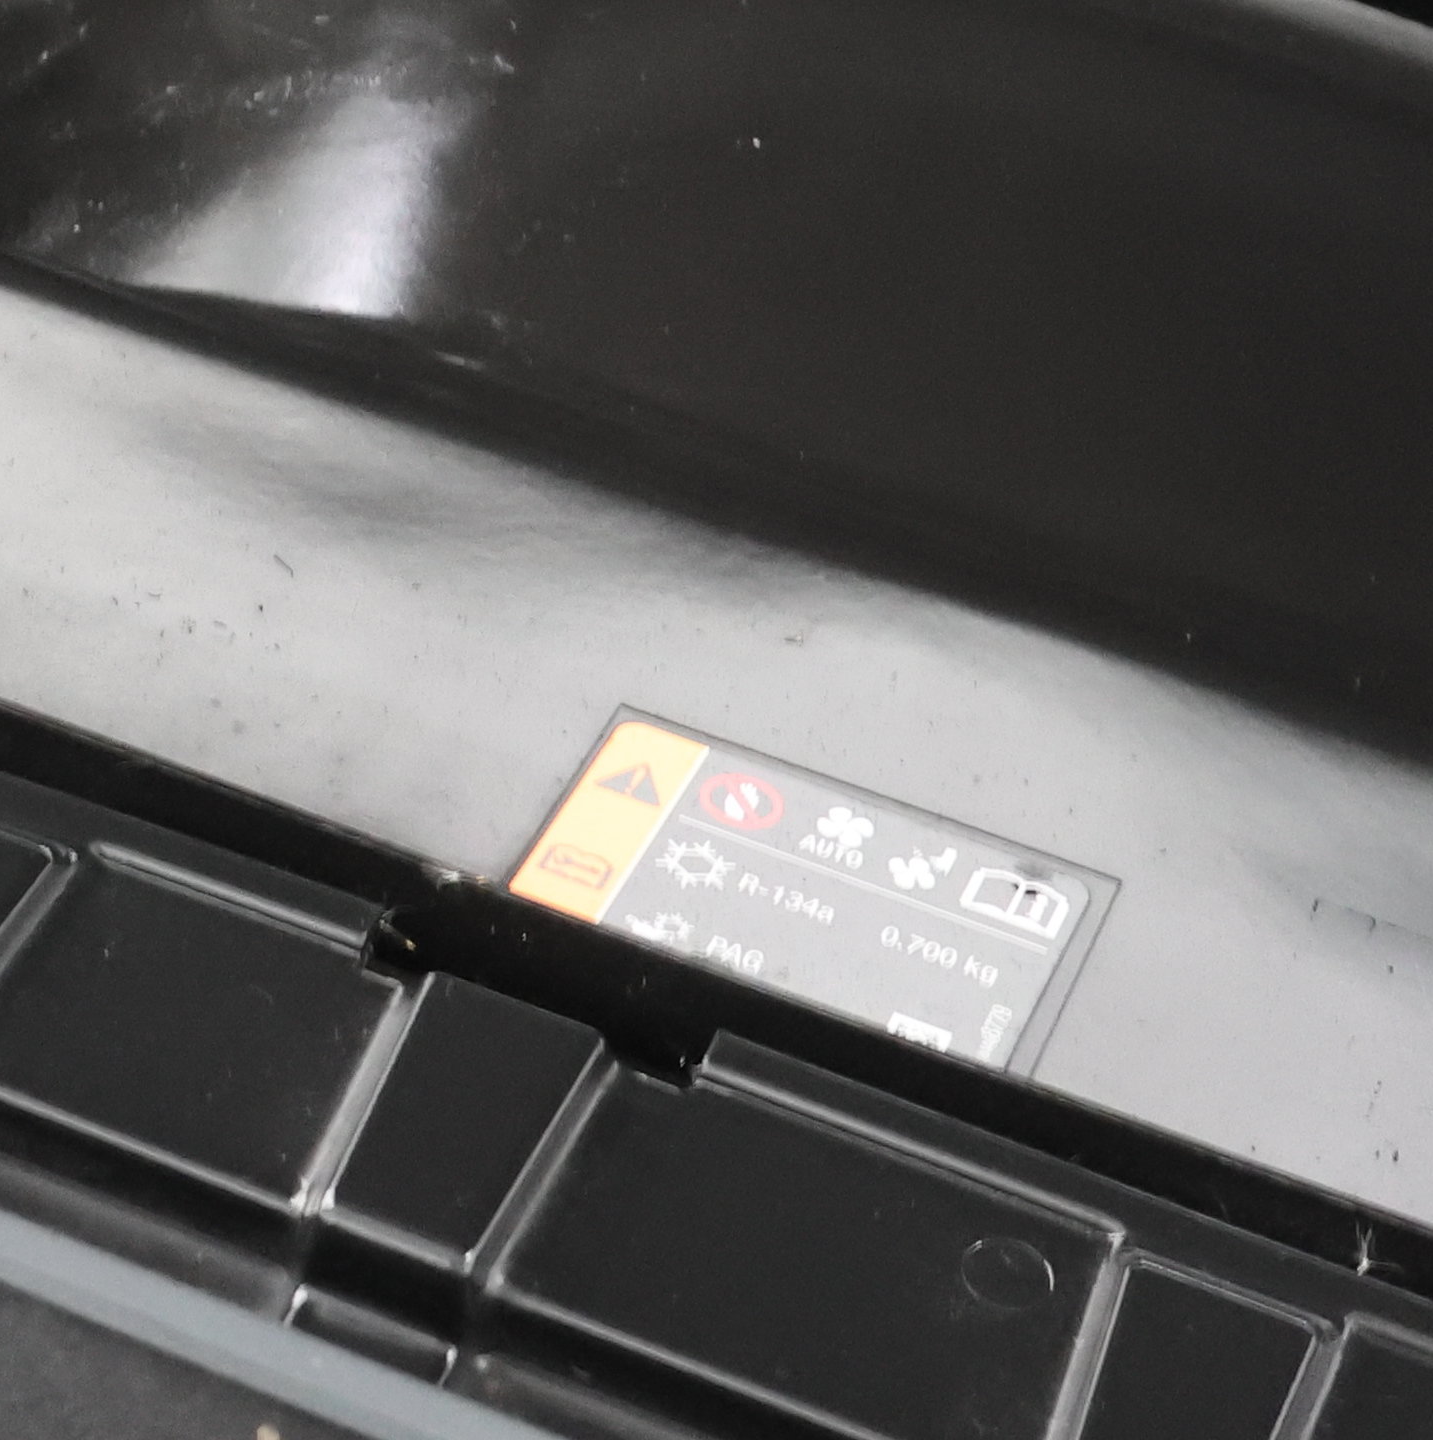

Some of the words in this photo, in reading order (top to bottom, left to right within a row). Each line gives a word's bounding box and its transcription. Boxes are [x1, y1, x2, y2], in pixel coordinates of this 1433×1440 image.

[799, 834, 863, 870] AUTO
[738, 872, 835, 925] R-134a
[880, 925, 957, 968] 0.700
[963, 955, 998, 988] kg
